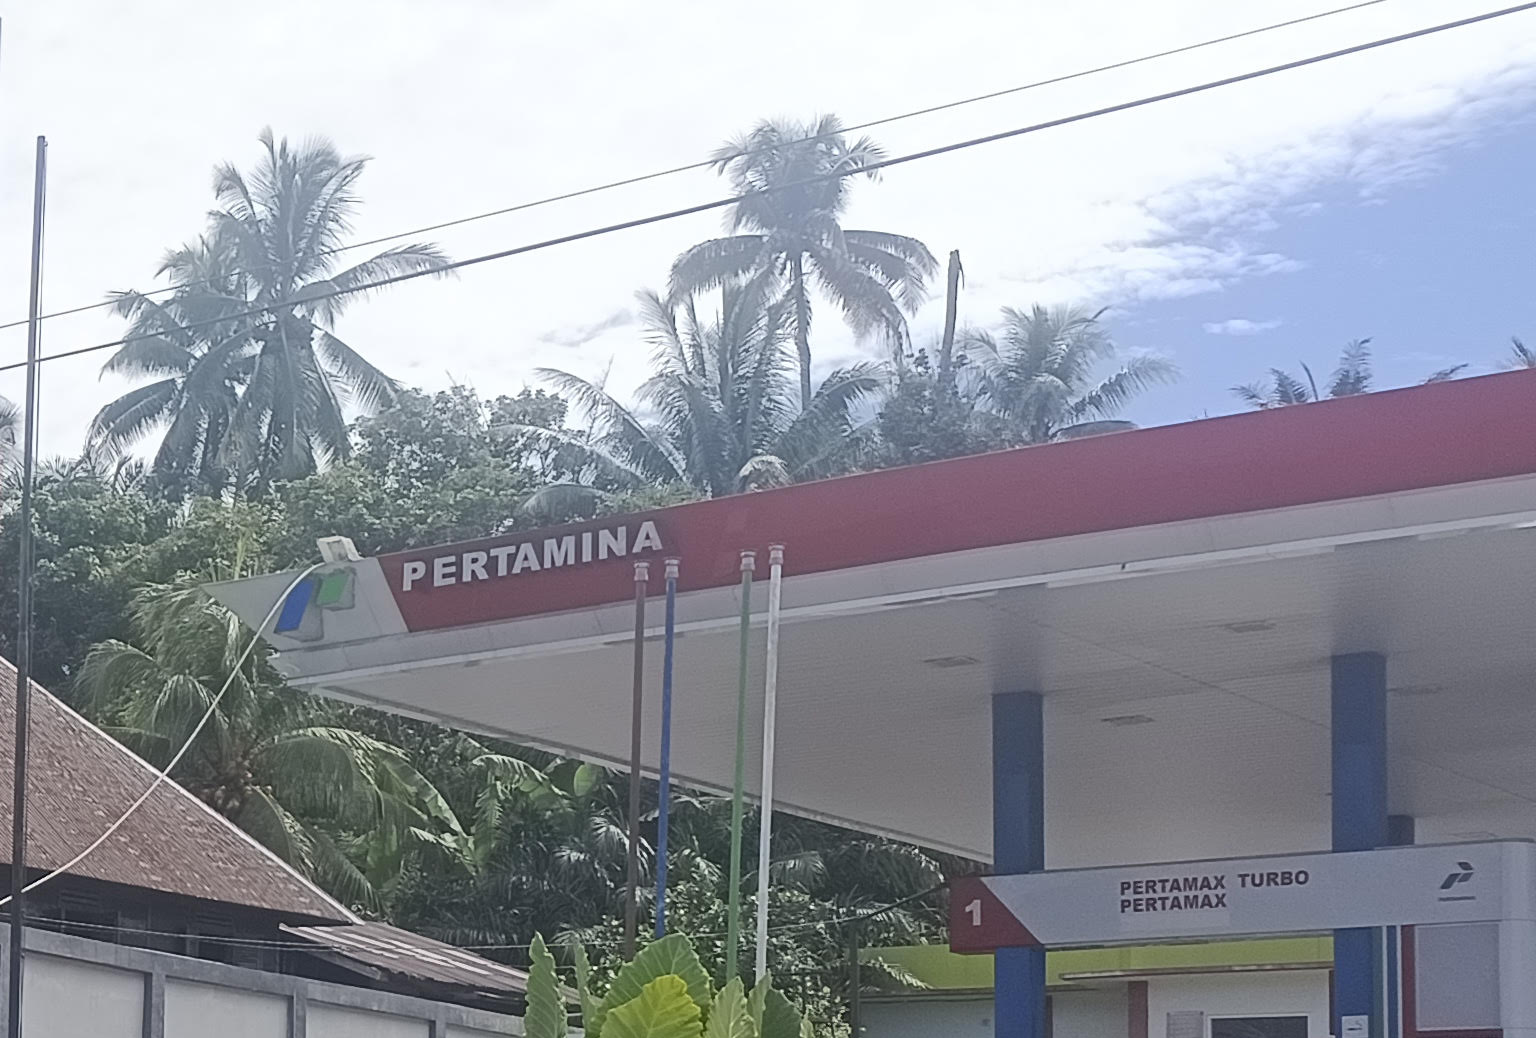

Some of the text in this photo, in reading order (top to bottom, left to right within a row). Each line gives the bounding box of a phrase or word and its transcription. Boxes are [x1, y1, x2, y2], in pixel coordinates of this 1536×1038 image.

[401, 520, 664, 592] PERTAMINA
[1119, 870, 1310, 896] PERTAMAX TURBO
[964, 899, 982, 926] 1
[1119, 892, 1227, 914] PERTAMAX
